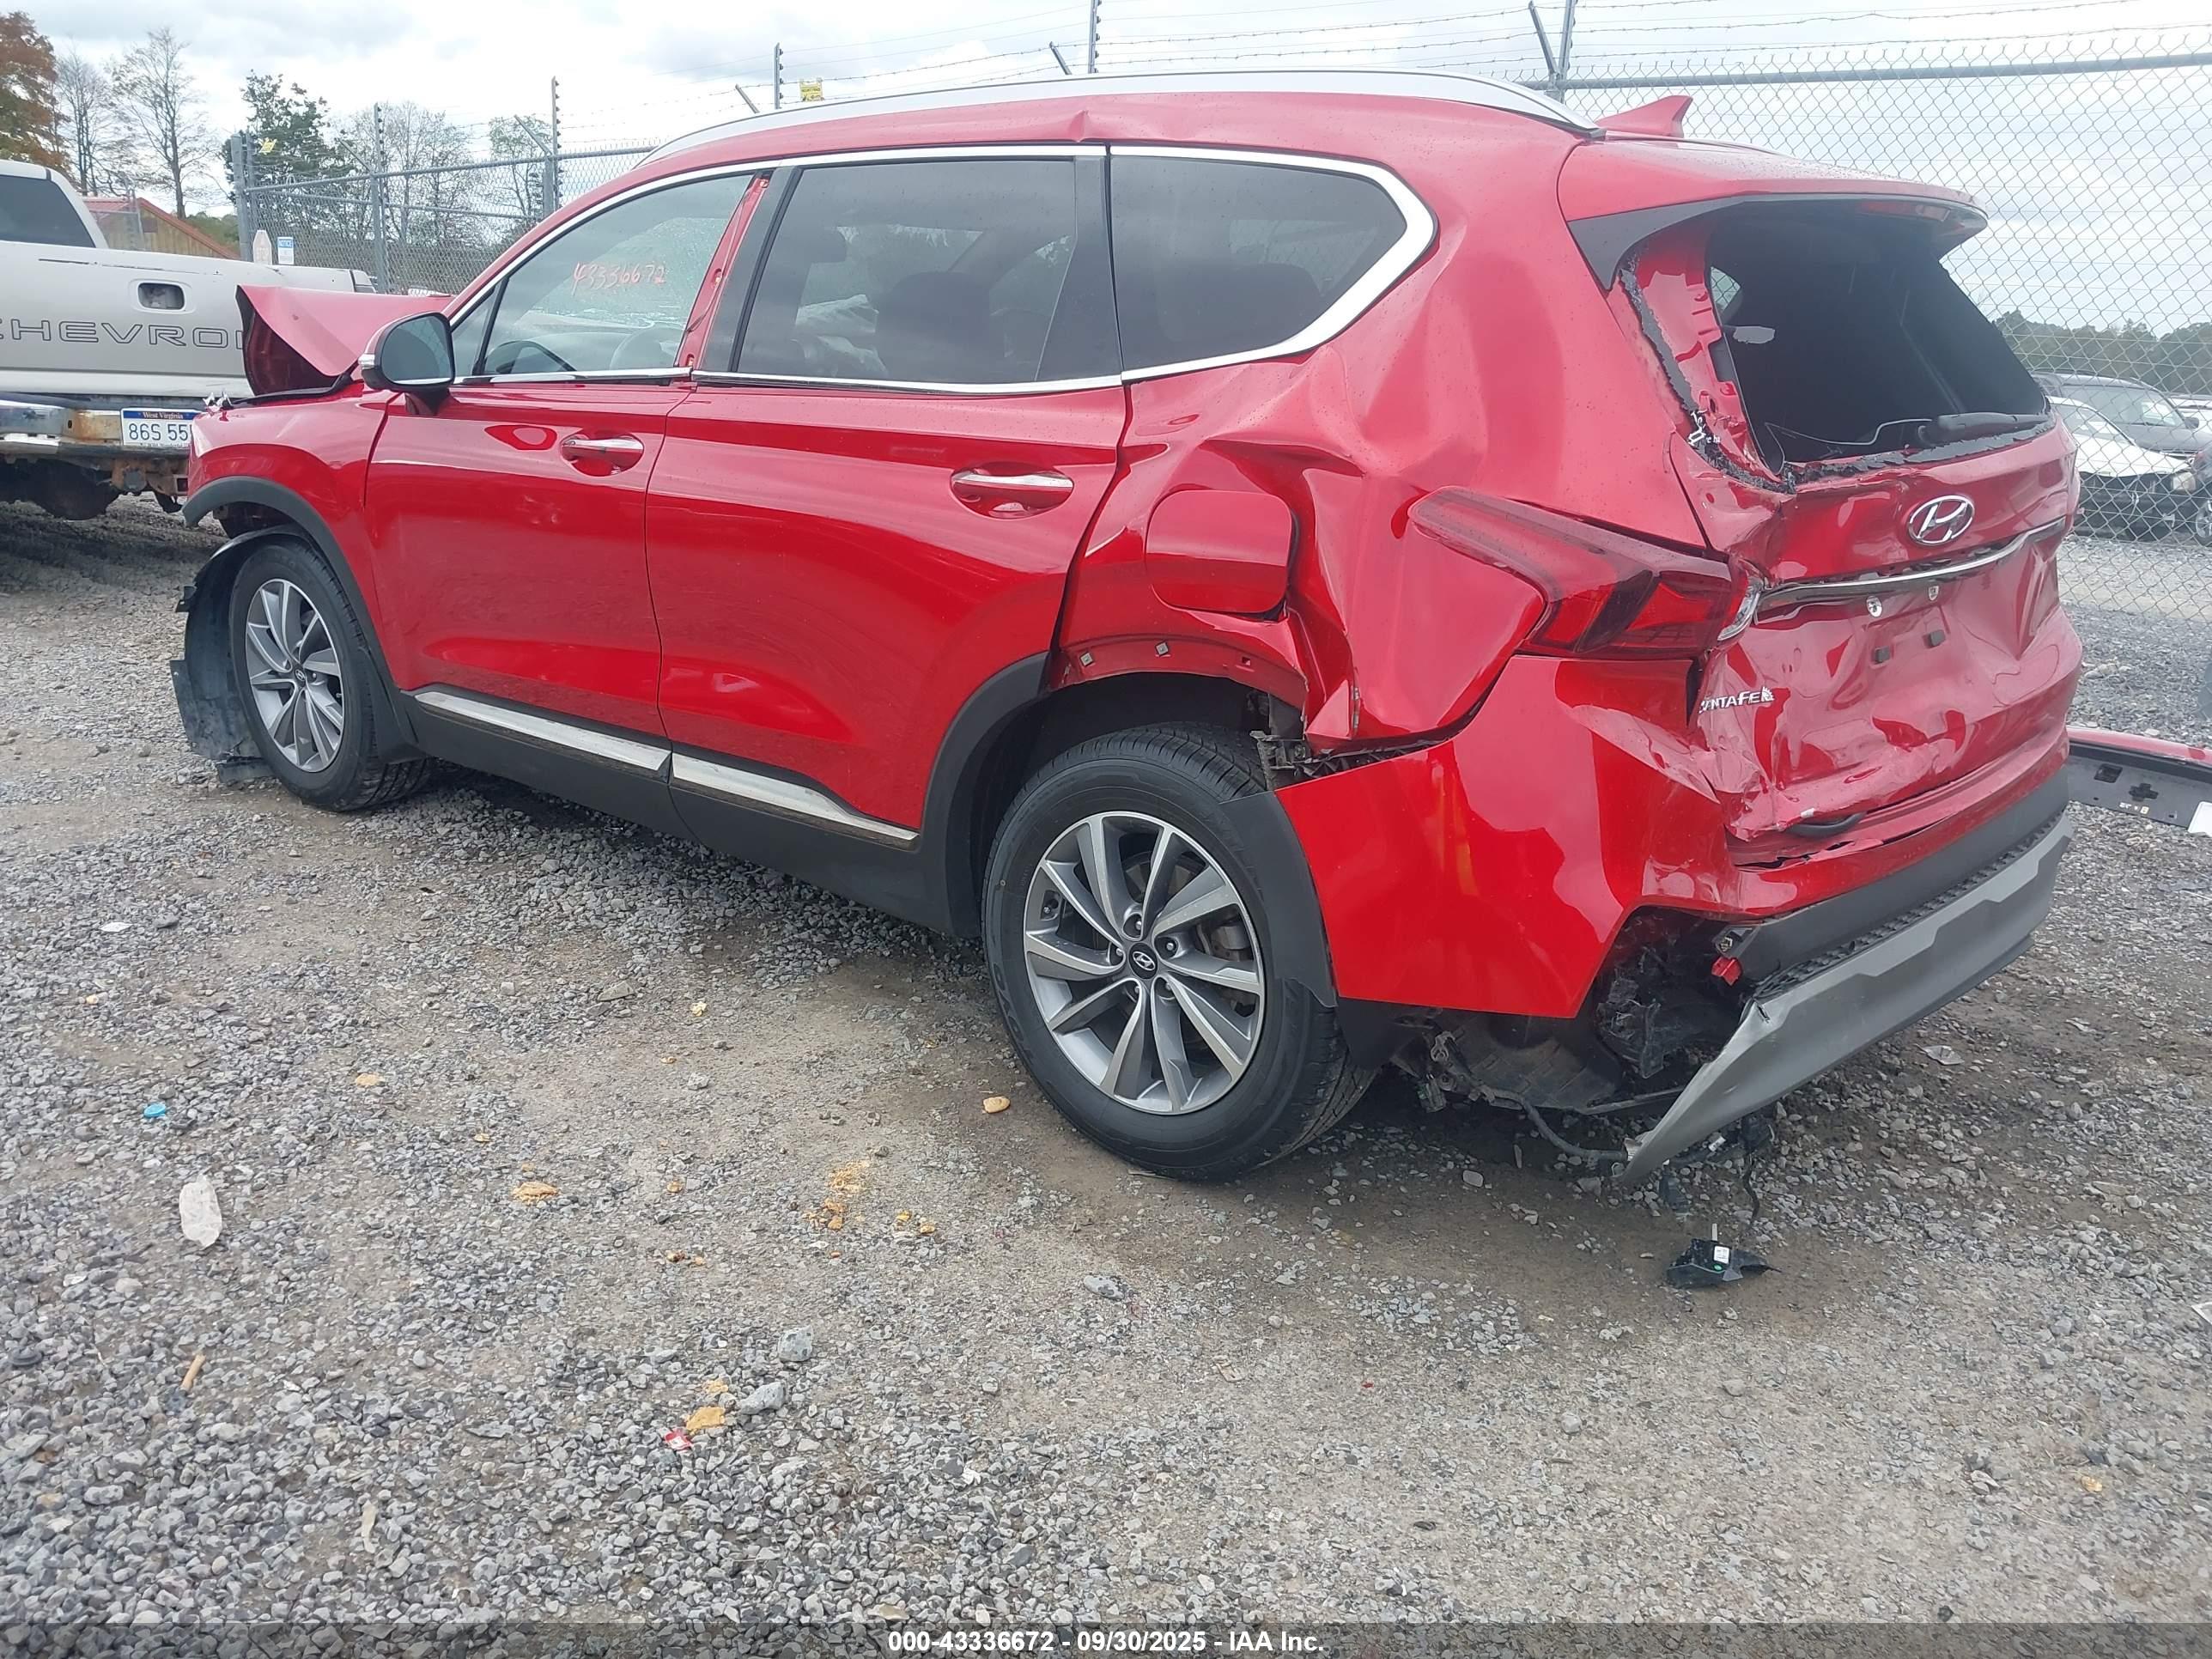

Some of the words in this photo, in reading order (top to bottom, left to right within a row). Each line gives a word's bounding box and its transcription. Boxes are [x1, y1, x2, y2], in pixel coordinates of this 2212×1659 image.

[571, 262, 666, 296] 43336672
[0, 319, 244, 350] HEVRO
[129, 422, 161, 441] 86S
[167, 423, 193, 441] 55
